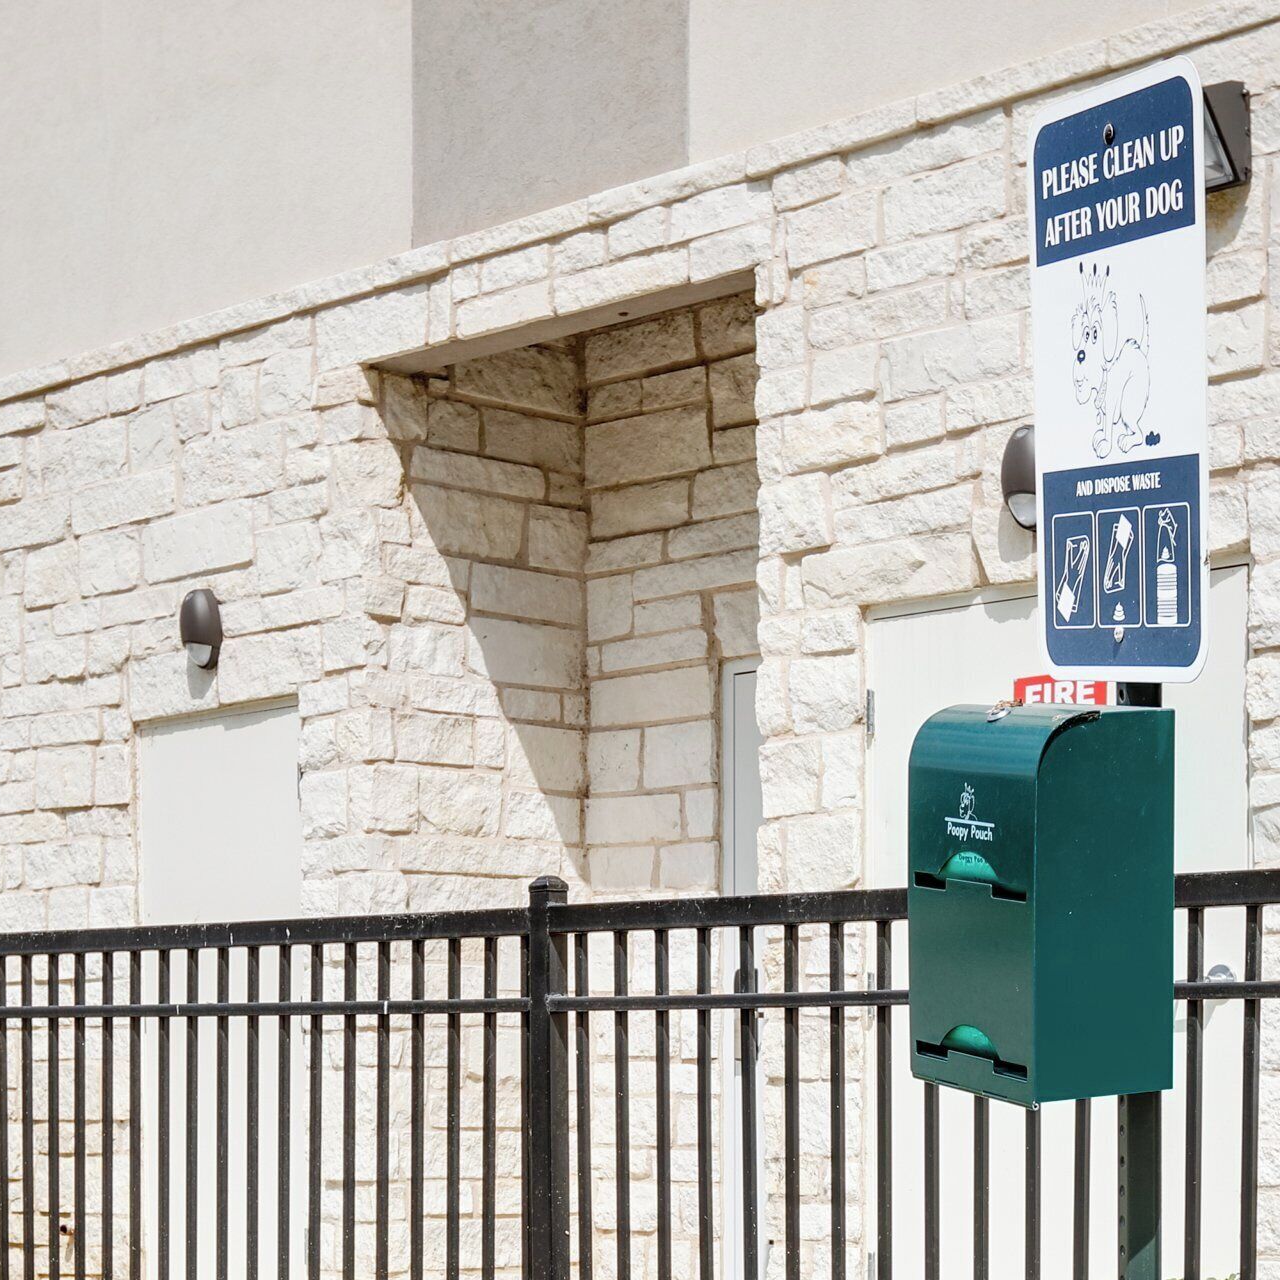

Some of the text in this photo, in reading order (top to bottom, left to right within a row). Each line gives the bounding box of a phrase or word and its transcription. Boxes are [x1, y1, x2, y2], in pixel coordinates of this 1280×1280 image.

[1042, 125, 1185, 200] PLEASE CLEAN UP
[1045, 178, 1184, 248] AFTER YOUR DOG
[1076, 472, 1161, 497] AND DISPOSE WASTE
[1025, 680, 1095, 705] FIRE
[947, 822, 993, 841] Poopy Pouch
